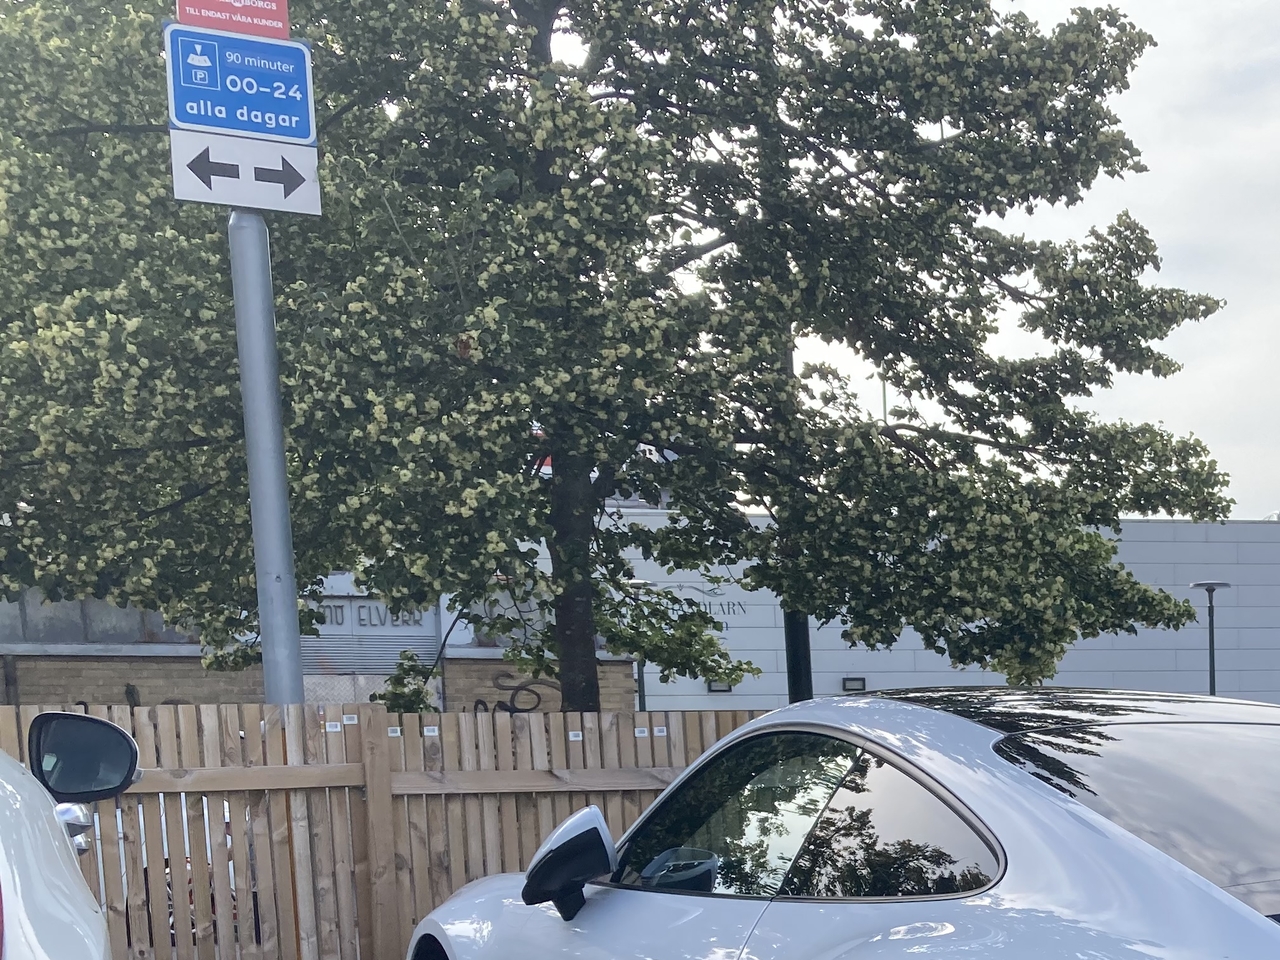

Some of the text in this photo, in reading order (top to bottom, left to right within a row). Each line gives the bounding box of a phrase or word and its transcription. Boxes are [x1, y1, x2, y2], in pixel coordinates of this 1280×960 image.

[185, 6, 283, 28] TILL ENDAST VÅRA KUNDER
[225, 51, 295, 73] 90 minuter
[186, 100, 300, 129] alla dagar
